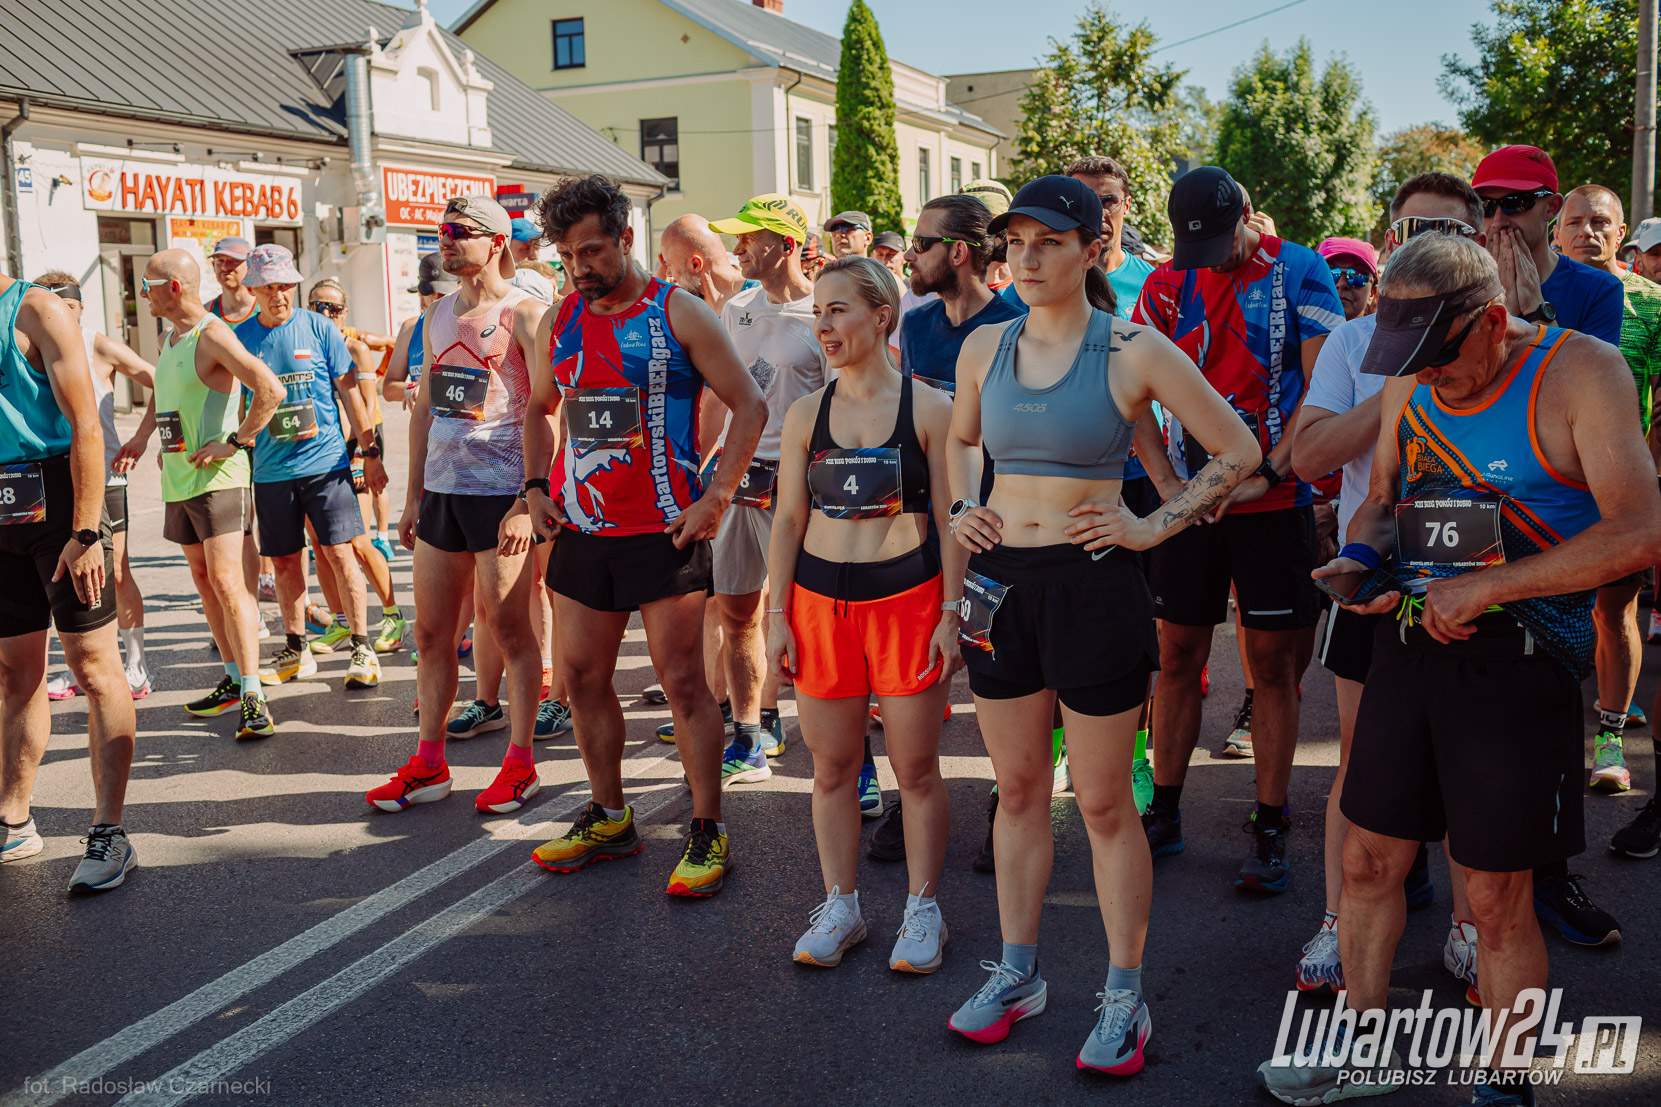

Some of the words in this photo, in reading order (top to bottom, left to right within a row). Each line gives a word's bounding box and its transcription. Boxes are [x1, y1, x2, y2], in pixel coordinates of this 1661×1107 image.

[121, 171, 206, 213] HAYATI
[214, 181, 284, 218] KEBAB
[287, 186, 298, 220] 6
[446, 384, 465, 402] 46
[282, 415, 300, 429] 64
[588, 410, 613, 429] 14
[160, 426, 172, 439] 26
[843, 474, 859, 495] 4
[1425, 521, 1459, 548] 76
